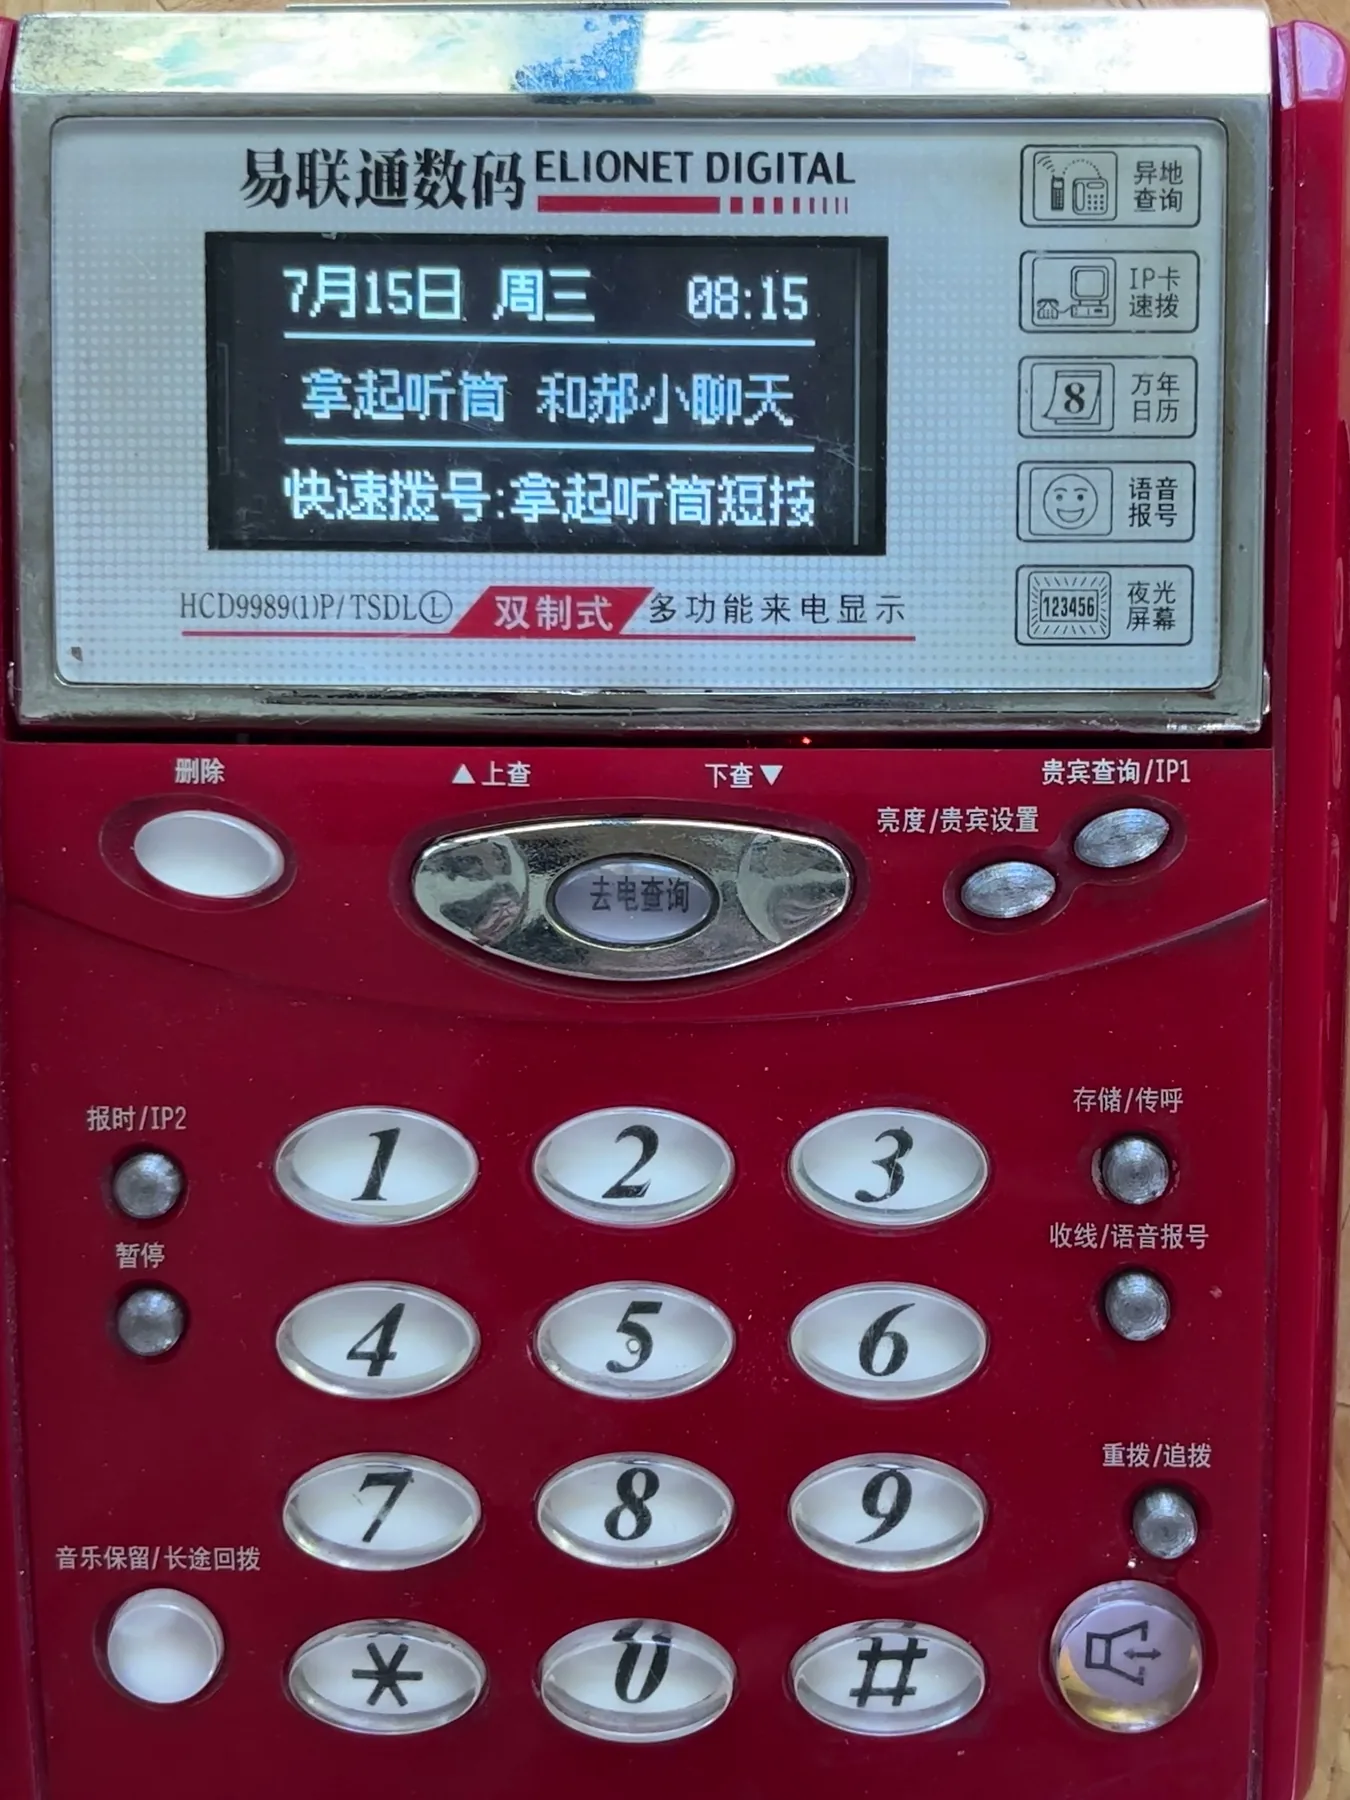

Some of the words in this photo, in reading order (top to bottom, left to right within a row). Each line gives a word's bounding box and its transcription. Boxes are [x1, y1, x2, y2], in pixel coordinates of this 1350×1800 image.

[240, 147, 527, 211] 易联通数码
[535, 150, 692, 184] ELIONET
[706, 151, 856, 185] DIGITAL
[1133, 160, 1184, 186] 异地
[1133, 187, 1184, 213] 查询
[283, 265, 462, 320] 7月15日
[492, 268, 596, 321] 周三
[686, 275, 810, 321] 08:15
[1130, 266, 1182, 291] IP卡
[1128, 292, 1180, 320] 速拨
[301, 368, 508, 422] 拿起听筒
[536, 371, 794, 427] 和郝小聊天
[1131, 371, 1181, 397] 万年
[1131, 398, 1180, 424] 日历
[1128, 476, 1179, 502] 语音
[1127, 502, 1178, 528] 报号
[1042, 596, 1096, 618] 123456
[1126, 580, 1177, 606] 夜光
[493, 593, 614, 633] 双制式
[648, 591, 907, 626] 多功能来电显示
[1125, 605, 1176, 632] 屏幕
[174, 757, 226, 785] 删除
[481, 760, 532, 788] 上查
[704, 761, 754, 789] 下查
[1041, 757, 1192, 787] 贵宾查询/IP1
[876, 804, 1040, 835] 亮度/贵宾设置
[589, 875, 690, 915] 去电查询
[1072, 1085, 1184, 1115] 存储/传呼
[87, 1104, 188, 1133] 报时/IP2
[350, 1126, 402, 1202] 1
[600, 1123, 661, 1201] 2
[854, 1125, 914, 1204] 3
[1049, 1222, 1209, 1252] 收线/语音报号
[115, 1240, 166, 1270] 暂停
[346, 1302, 407, 1377] 4
[605, 1300, 664, 1375] 5
[857, 1302, 917, 1378] 6
[1102, 1442, 1213, 1470] 重拨/追拨
[357, 1467, 416, 1543] 7
[603, 1466, 661, 1541] 8
[854, 1468, 914, 1545] 9
[55, 1545, 262, 1573] 音乐保留/长途回拨
